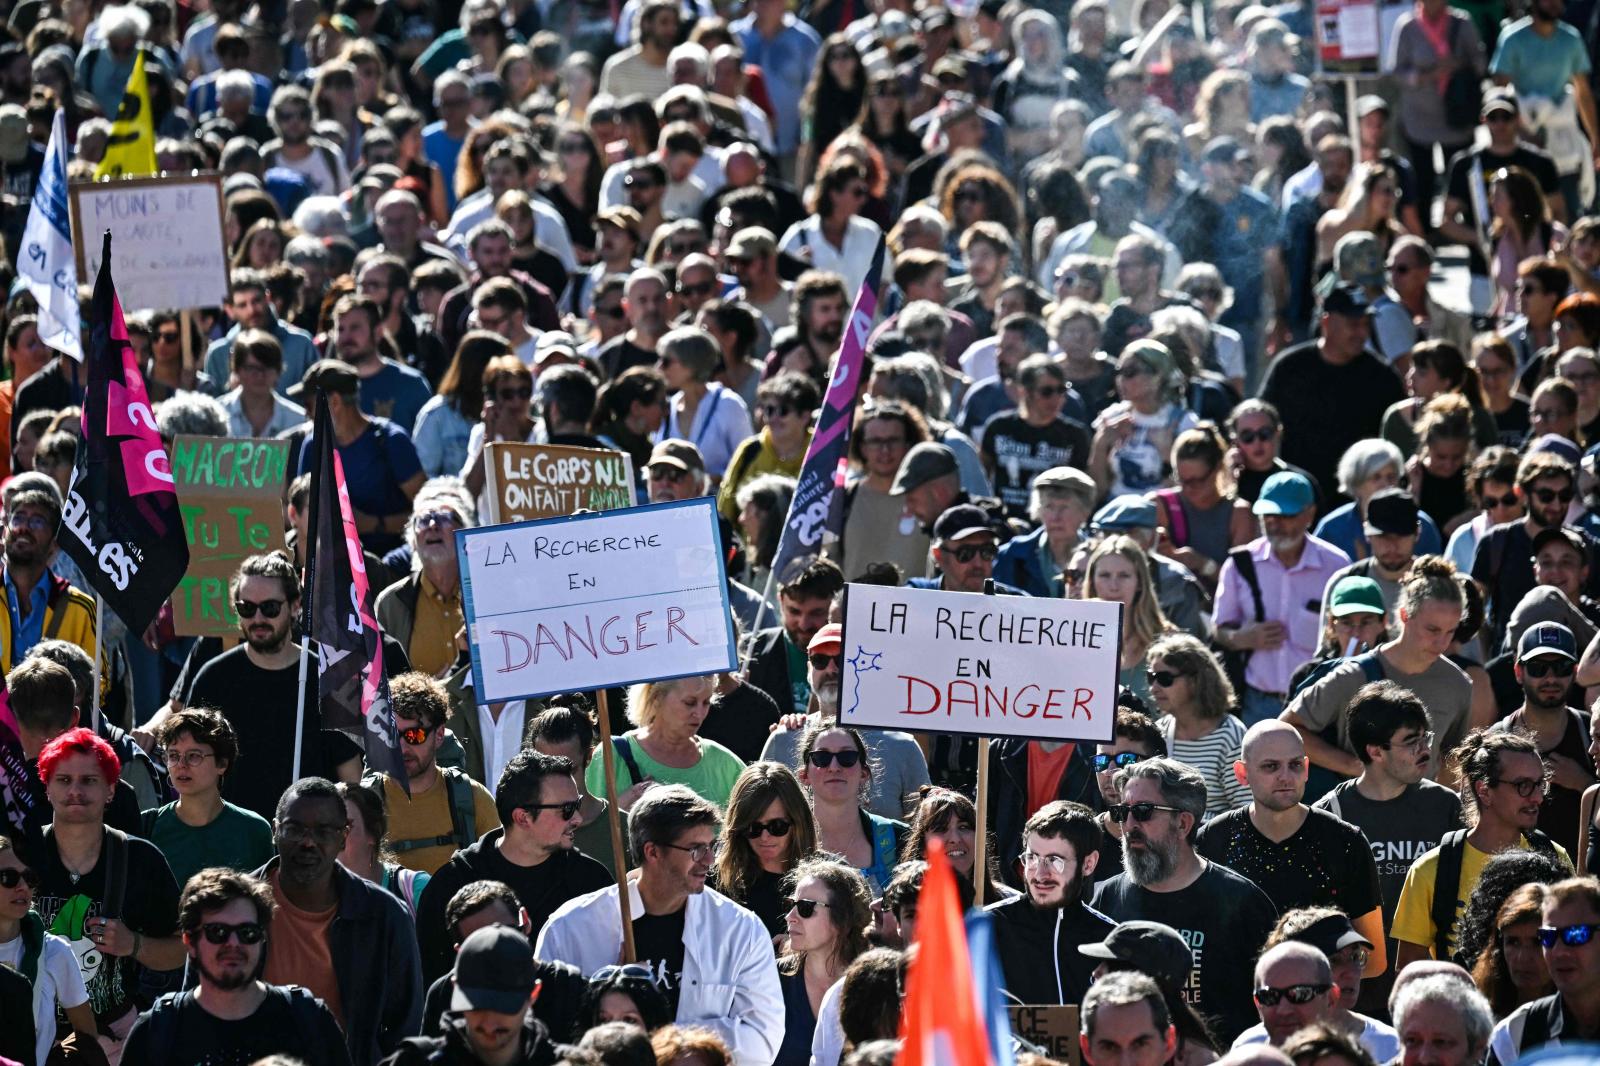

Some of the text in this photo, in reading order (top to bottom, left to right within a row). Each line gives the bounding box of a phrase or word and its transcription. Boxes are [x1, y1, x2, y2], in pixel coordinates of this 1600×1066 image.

[95, 189, 197, 219] MOINS DE
[172, 441, 288, 488] MACRON
[595, 458, 627, 486] NU
[227, 506, 270, 549] Te
[484, 534, 662, 567] LA RECHERCHE
[568, 573, 597, 591] EN
[491, 606, 699, 673] DANGER
[870, 602, 1105, 649] LA RECHERCHE
[956, 658, 992, 679] EN
[897, 675, 1094, 721] DANGER
